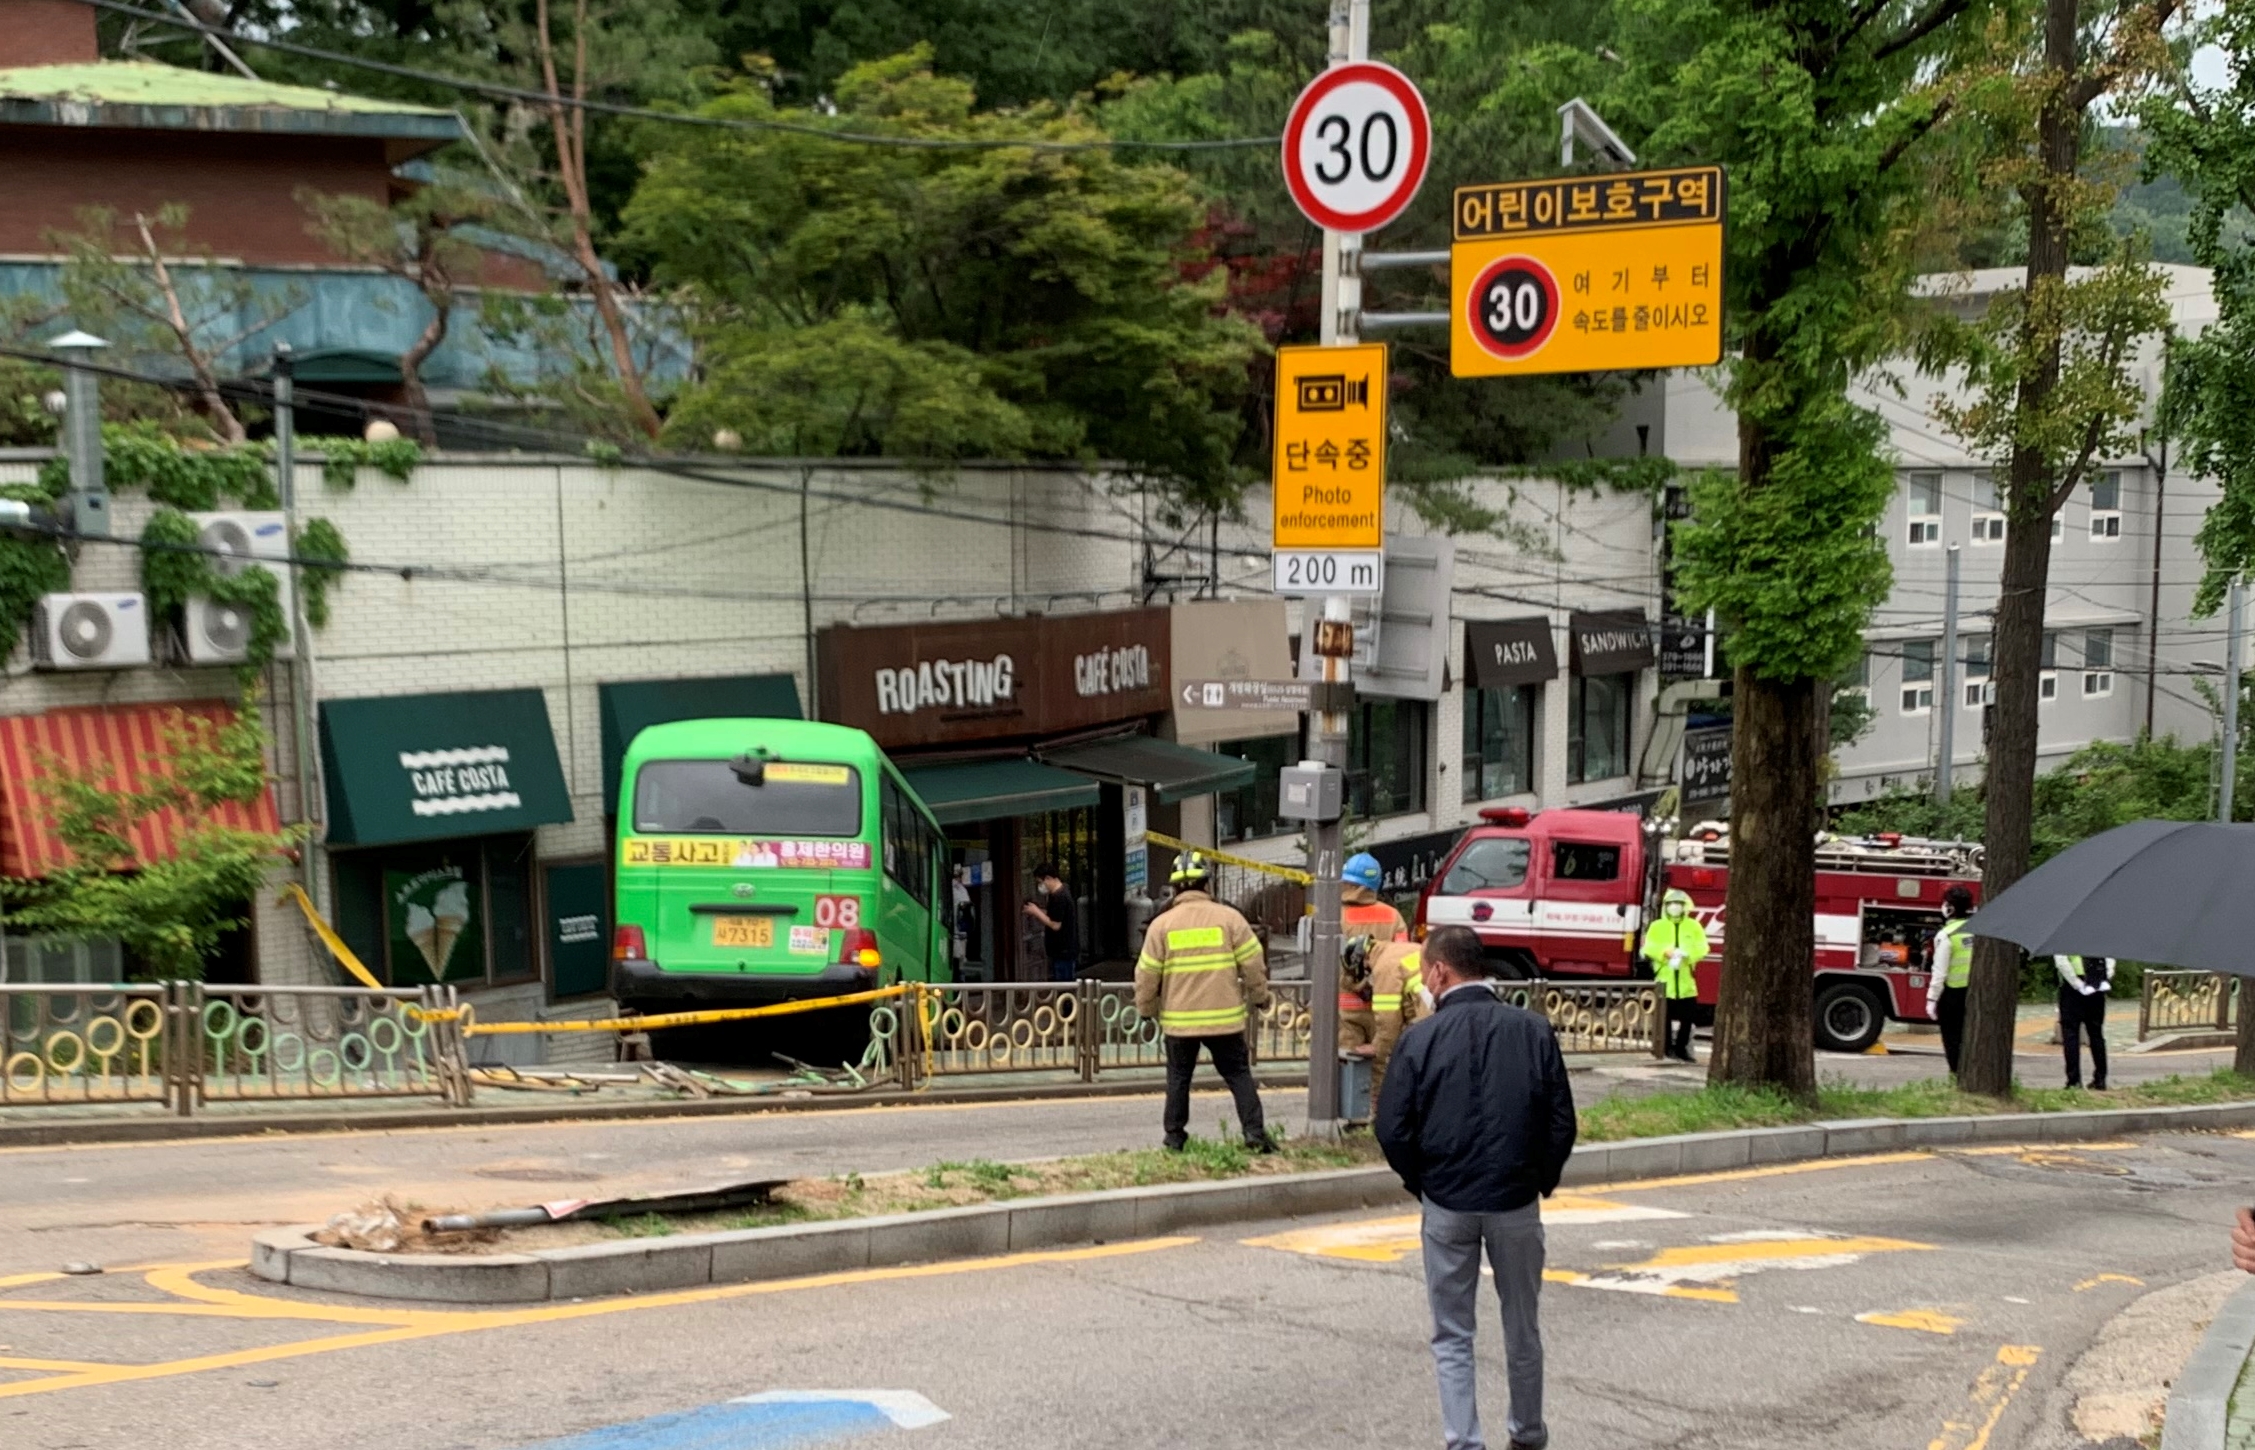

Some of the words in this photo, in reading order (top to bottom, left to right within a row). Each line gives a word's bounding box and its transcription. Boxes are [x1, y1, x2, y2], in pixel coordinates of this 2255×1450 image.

[1314, 110, 1398, 186] 30
[1461, 173, 1709, 233] 어린이보호구역
[1487, 282, 1539, 333] 30
[1572, 306, 1628, 334] 속도를
[1633, 301, 1709, 332] 줄이시오
[1285, 437, 1372, 473] 단속중
[1302, 484, 1352, 505] Photo
[1280, 509, 1375, 529] enforcement
[1287, 554, 1337, 586] 200
[1350, 562, 1374, 586] m
[1494, 640, 1538, 666] PASTA
[1581, 630, 1649, 655] SANDWICH
[875, 653, 1013, 715] ROASTING
[1074, 645, 1109, 698] CAFÉ
[1110, 644, 1150, 693] COSTA
[457, 764, 510, 793] COSTA
[628, 840, 719, 864] 교통사고
[815, 897, 859, 927] 08
